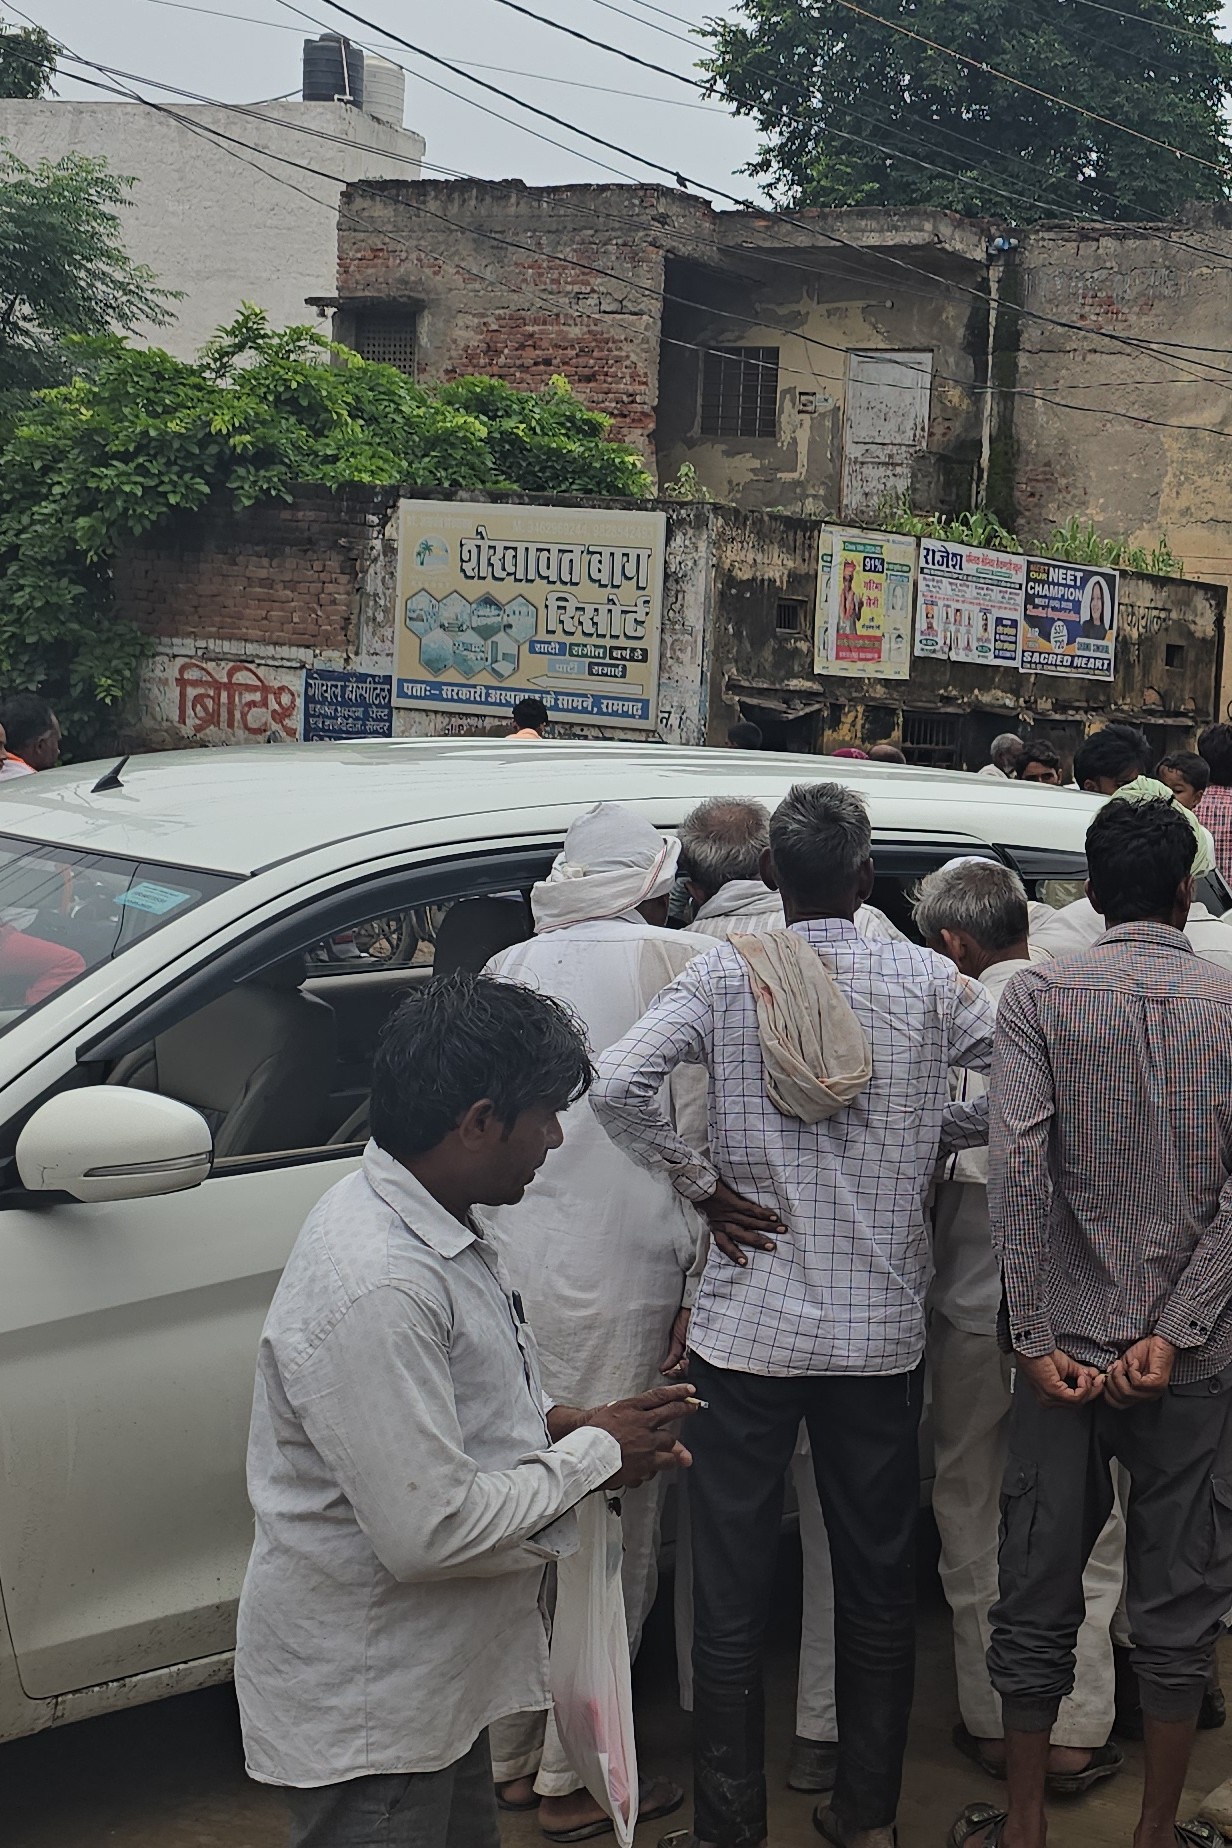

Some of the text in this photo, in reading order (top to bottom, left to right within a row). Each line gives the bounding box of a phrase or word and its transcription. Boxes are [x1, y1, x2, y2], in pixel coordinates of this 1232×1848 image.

[460, 525, 652, 590] शेखावत बाग
[864, 559, 882, 572] 91%
[923, 545, 963, 571] राजेश
[1030, 572, 1048, 581] OUR
[1049, 567, 1083, 586] NEET
[1027, 582, 1084, 602] CHAMPION
[545, 591, 651, 639] रिसोर्ट
[534, 641, 559, 654] शादी
[572, 643, 604, 657] संगीत
[1023, 651, 1071, 666] SACRED
[1073, 656, 1110, 670] HEART
[591, 665, 623, 677] सगाई
[307, 673, 344, 702] गोयल
[441, 685, 486, 702] सरकारी
[542, 691, 555, 707] के
[601, 699, 642, 718] रामगढ़
